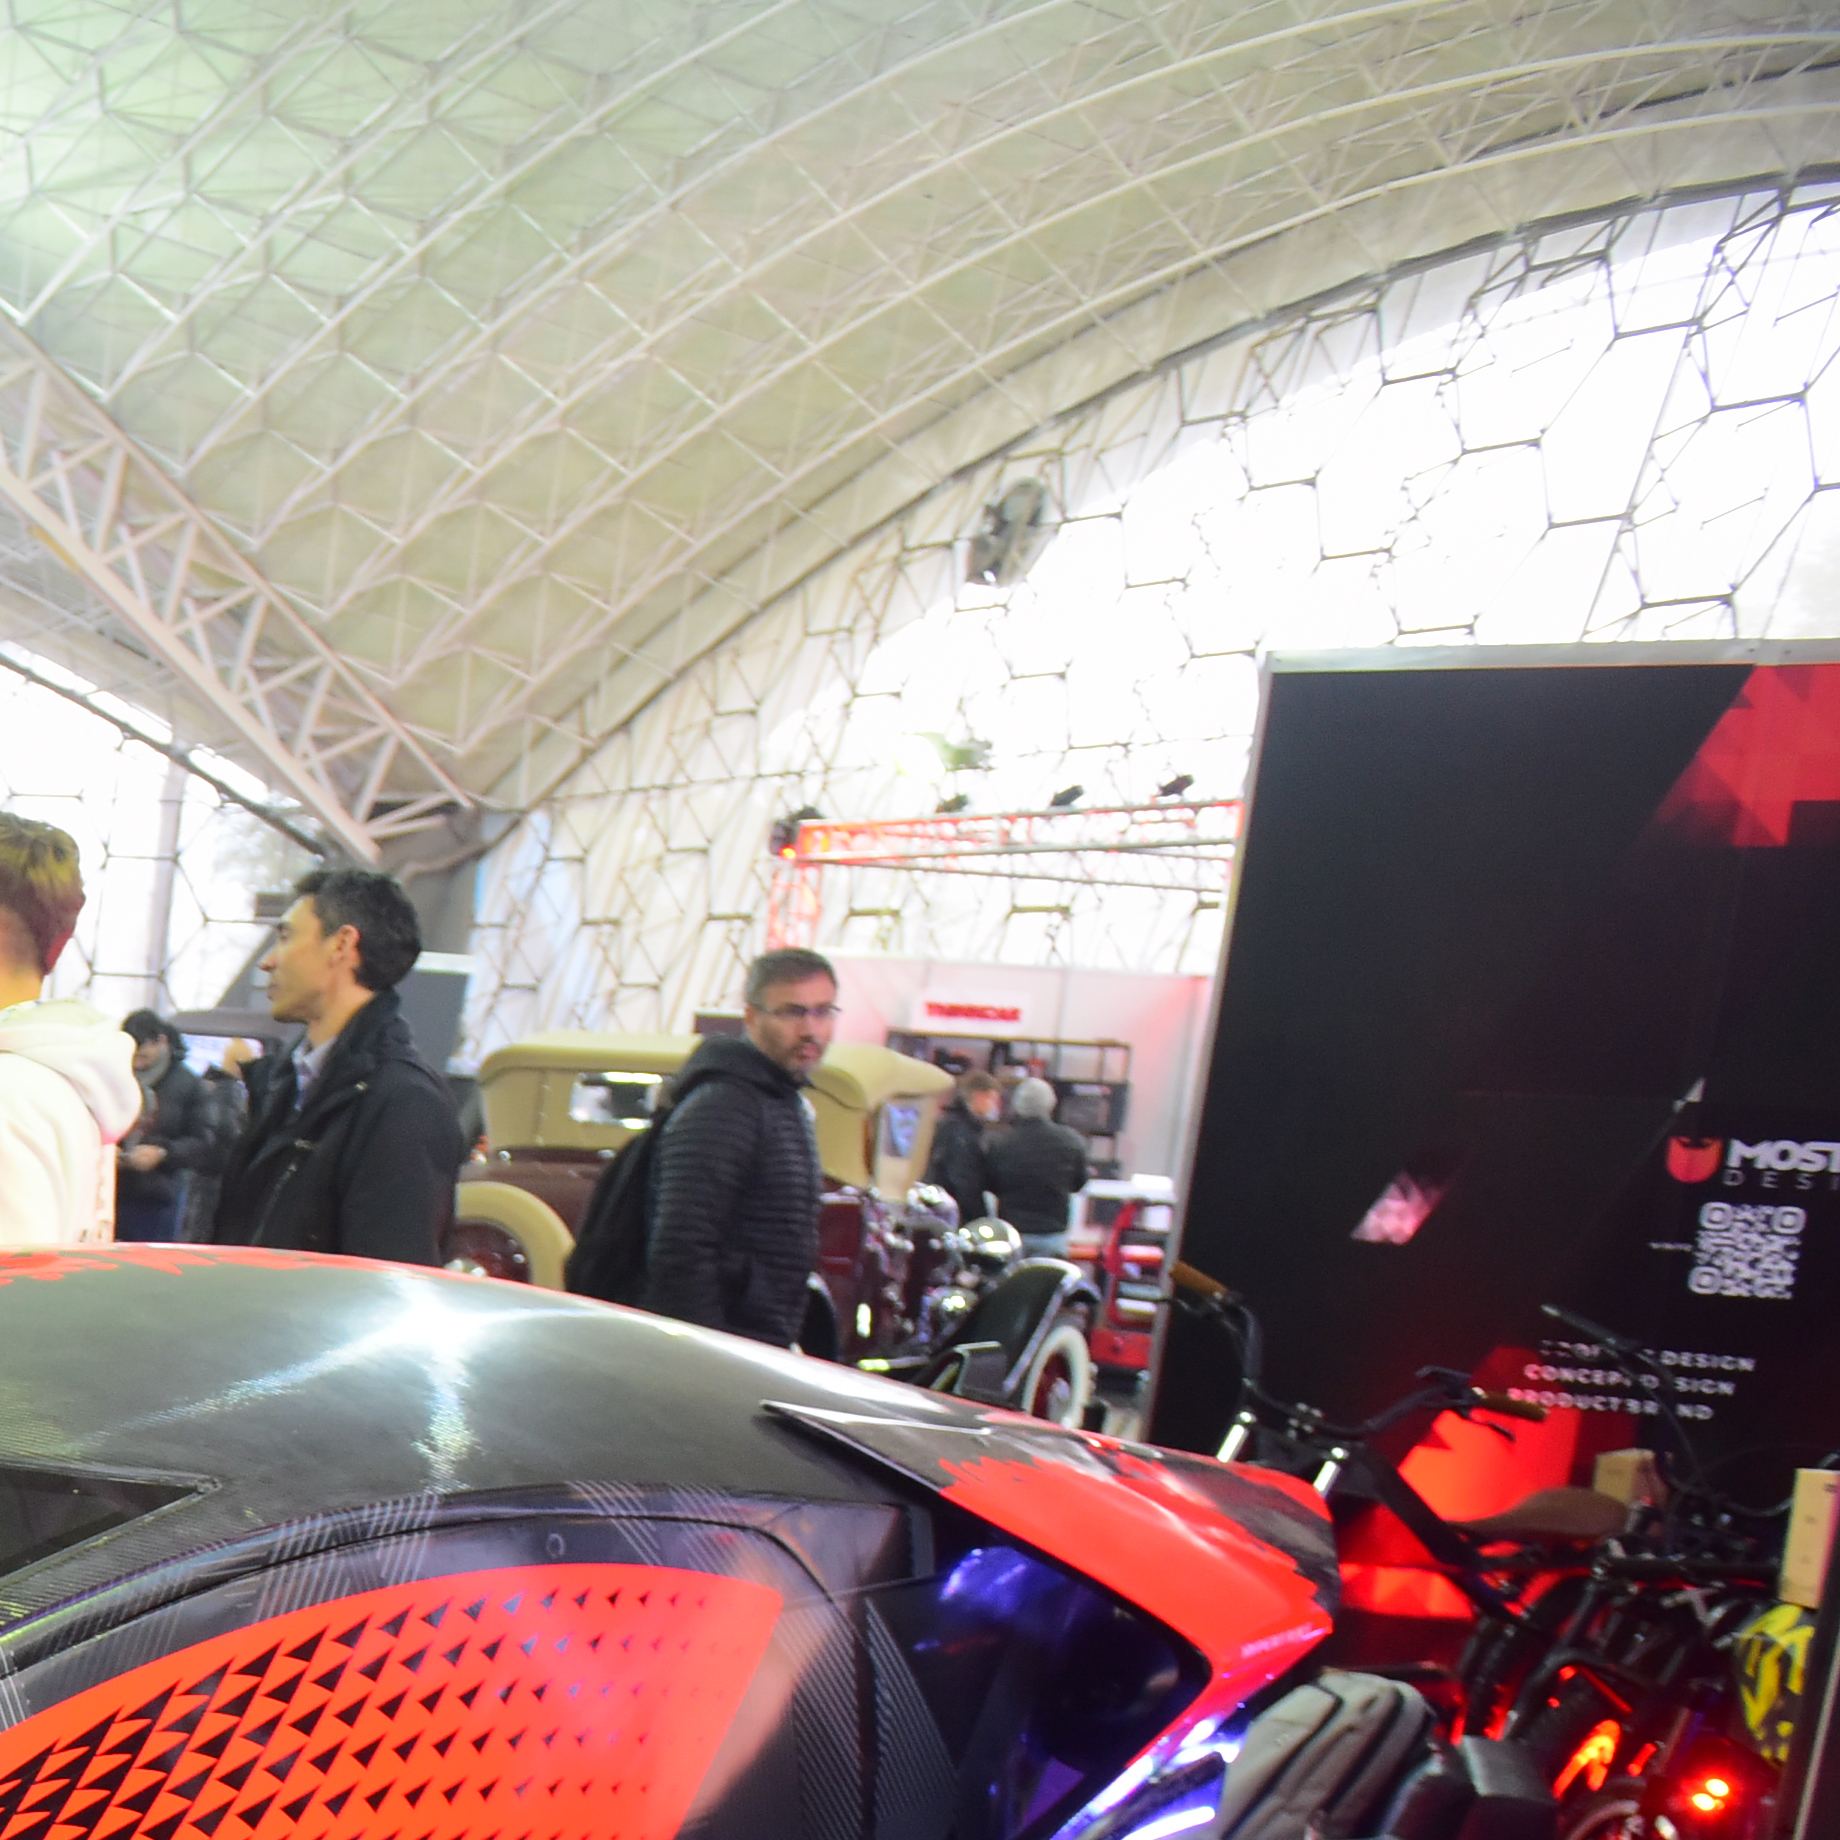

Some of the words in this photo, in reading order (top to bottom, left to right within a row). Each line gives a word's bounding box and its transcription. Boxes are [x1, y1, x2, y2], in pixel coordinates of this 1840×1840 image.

[1660, 1350, 1756, 1373] DESIGN
[1639, 1374, 1736, 1396] DSIGN
[1623, 1397, 1714, 1420] BRND
